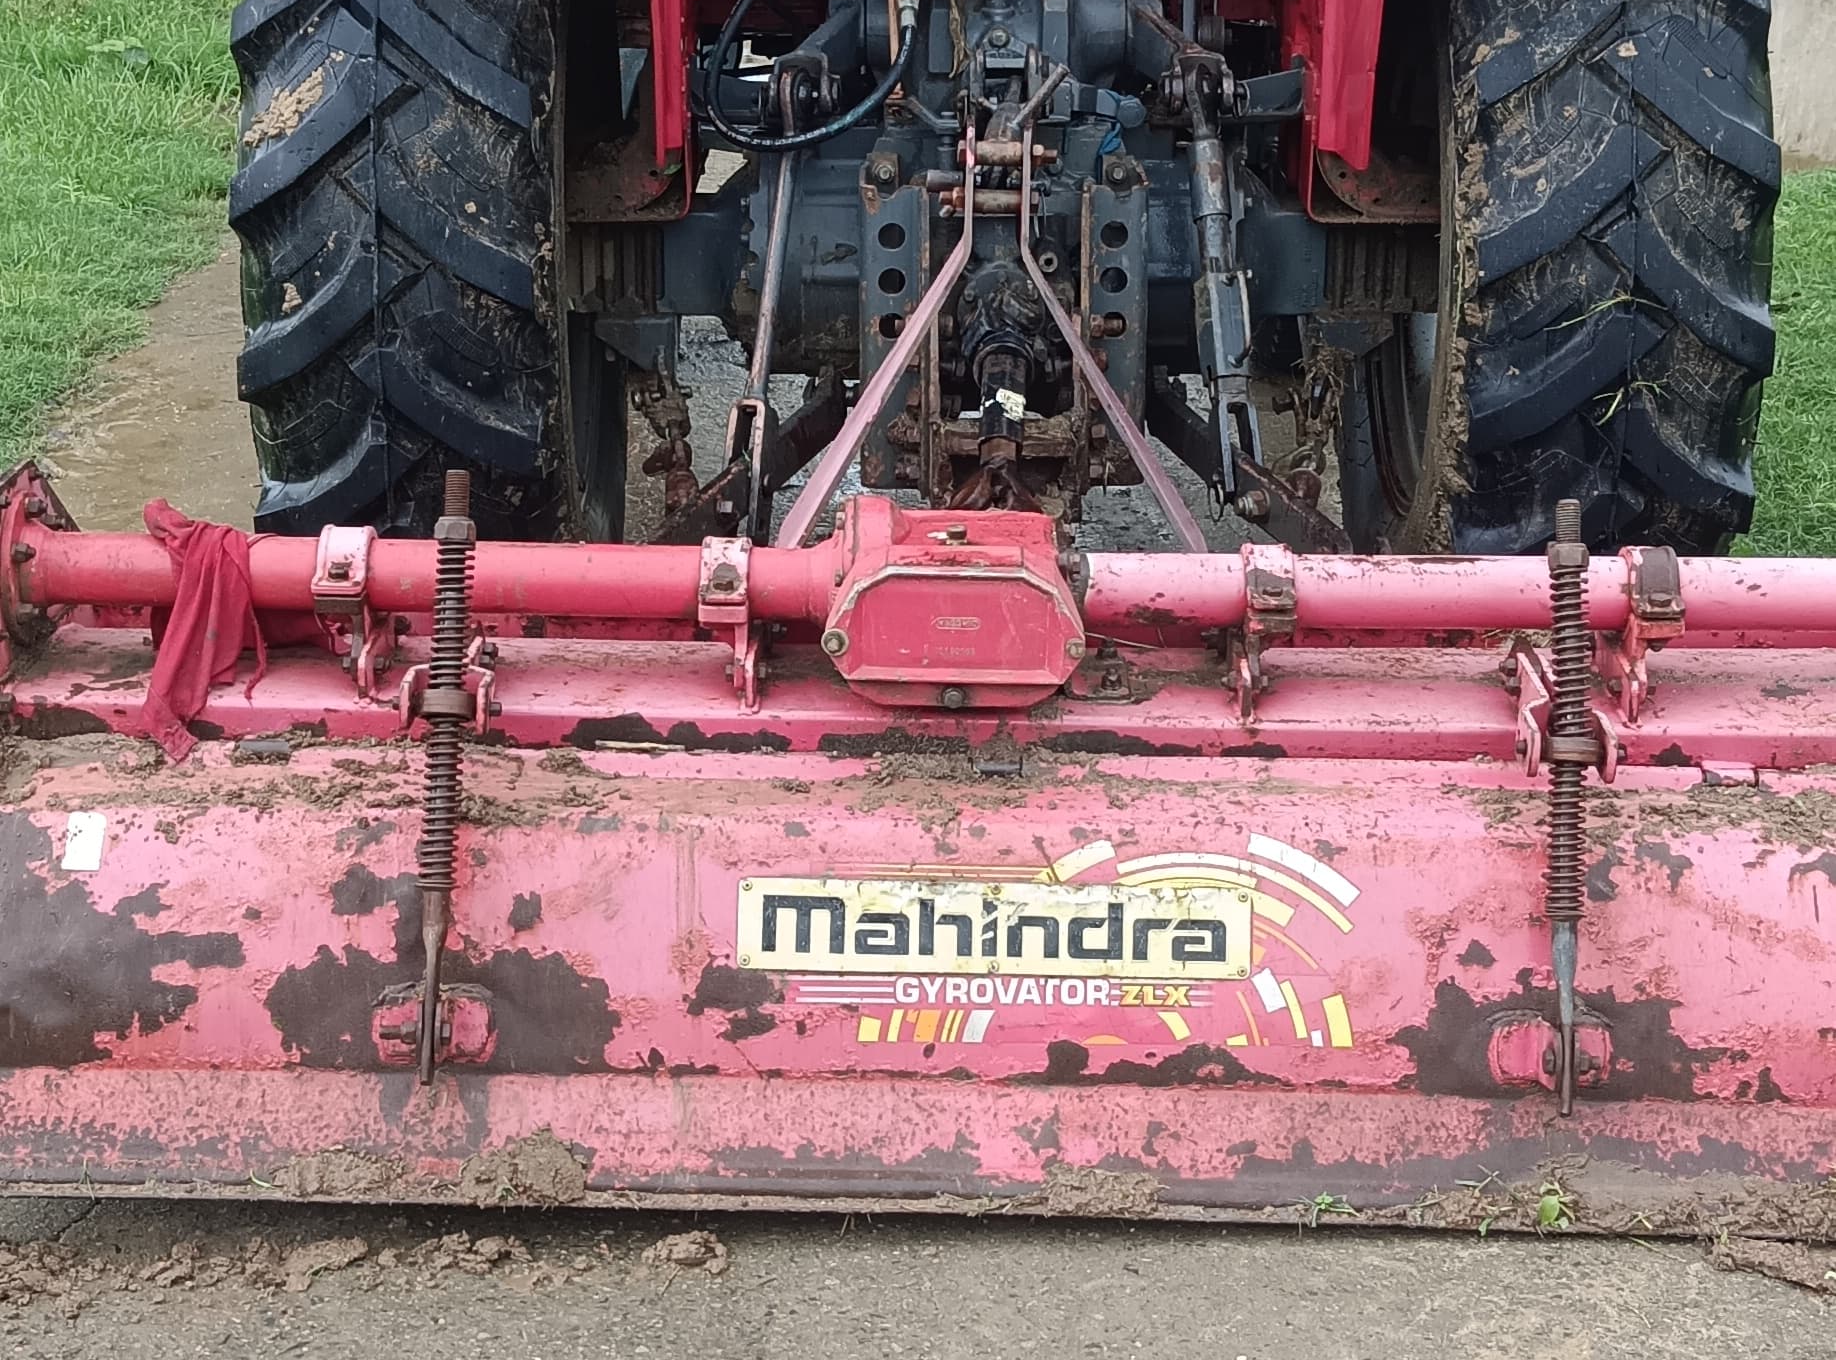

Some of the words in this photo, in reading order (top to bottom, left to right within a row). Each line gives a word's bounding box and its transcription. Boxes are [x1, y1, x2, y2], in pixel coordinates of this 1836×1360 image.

[763, 893, 1228, 964] Mahindra
[894, 975, 1111, 1007] GYROVATOR
[1118, 984, 1191, 1007] ZLX
